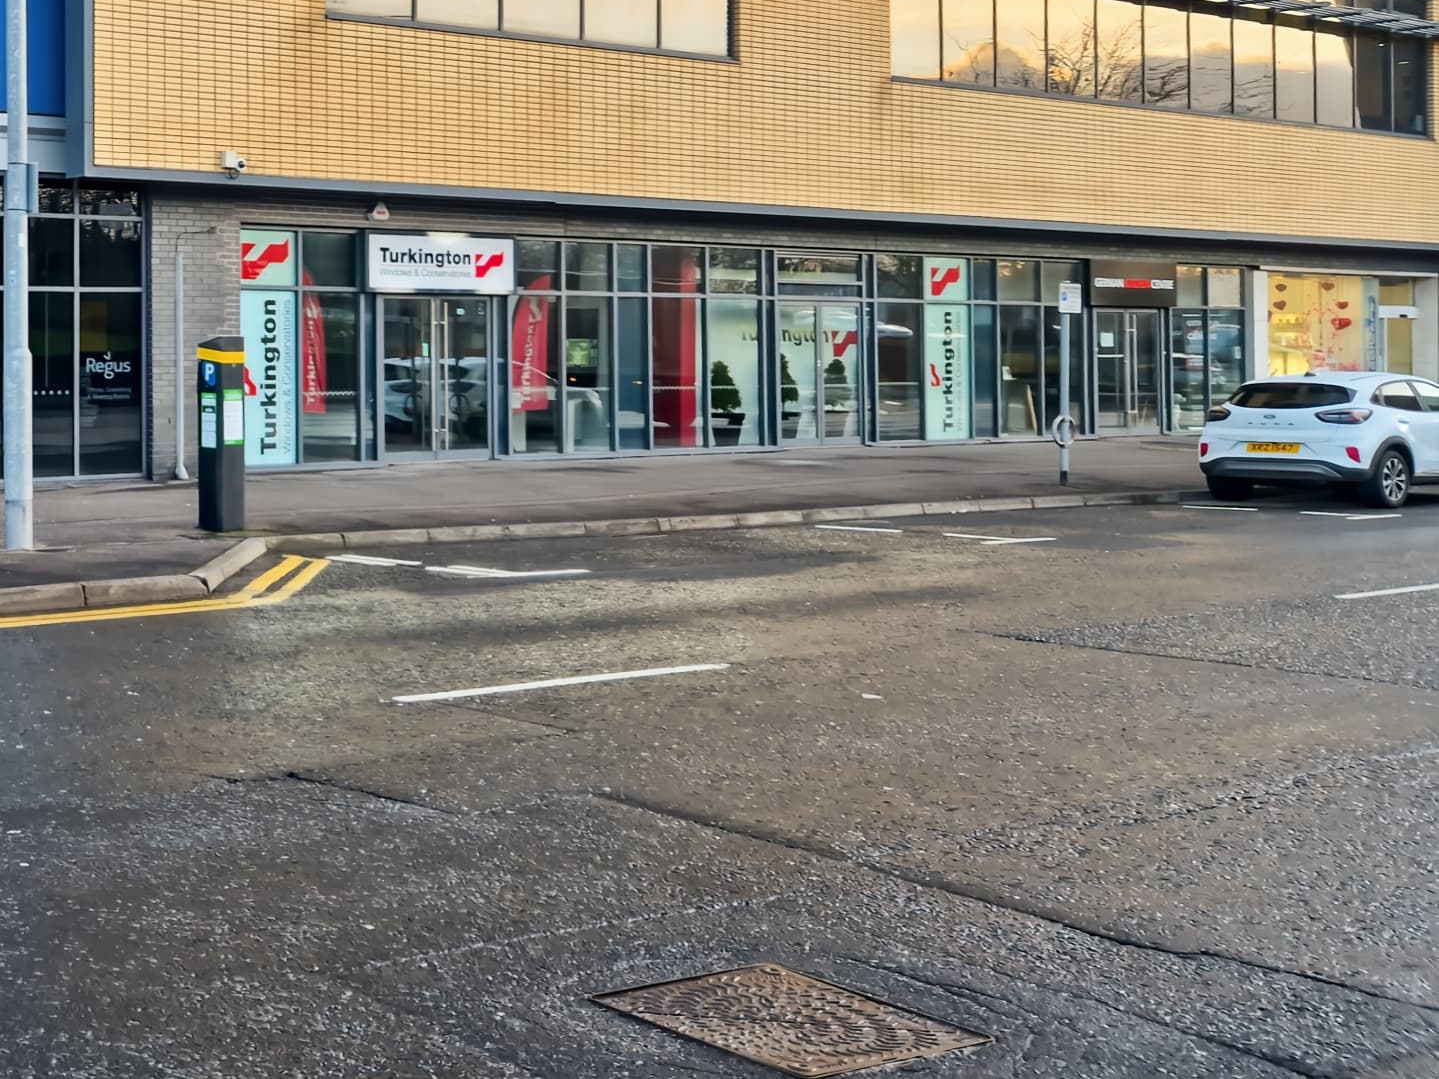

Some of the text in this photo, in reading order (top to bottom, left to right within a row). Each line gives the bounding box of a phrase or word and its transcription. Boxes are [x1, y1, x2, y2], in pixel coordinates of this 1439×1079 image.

[380, 247, 472, 268] Turkington
[85, 356, 132, 380] Regus
[205, 362, 215, 382] P
[260, 299, 281, 455] Turkington
[942, 311, 955, 432] Turkington
